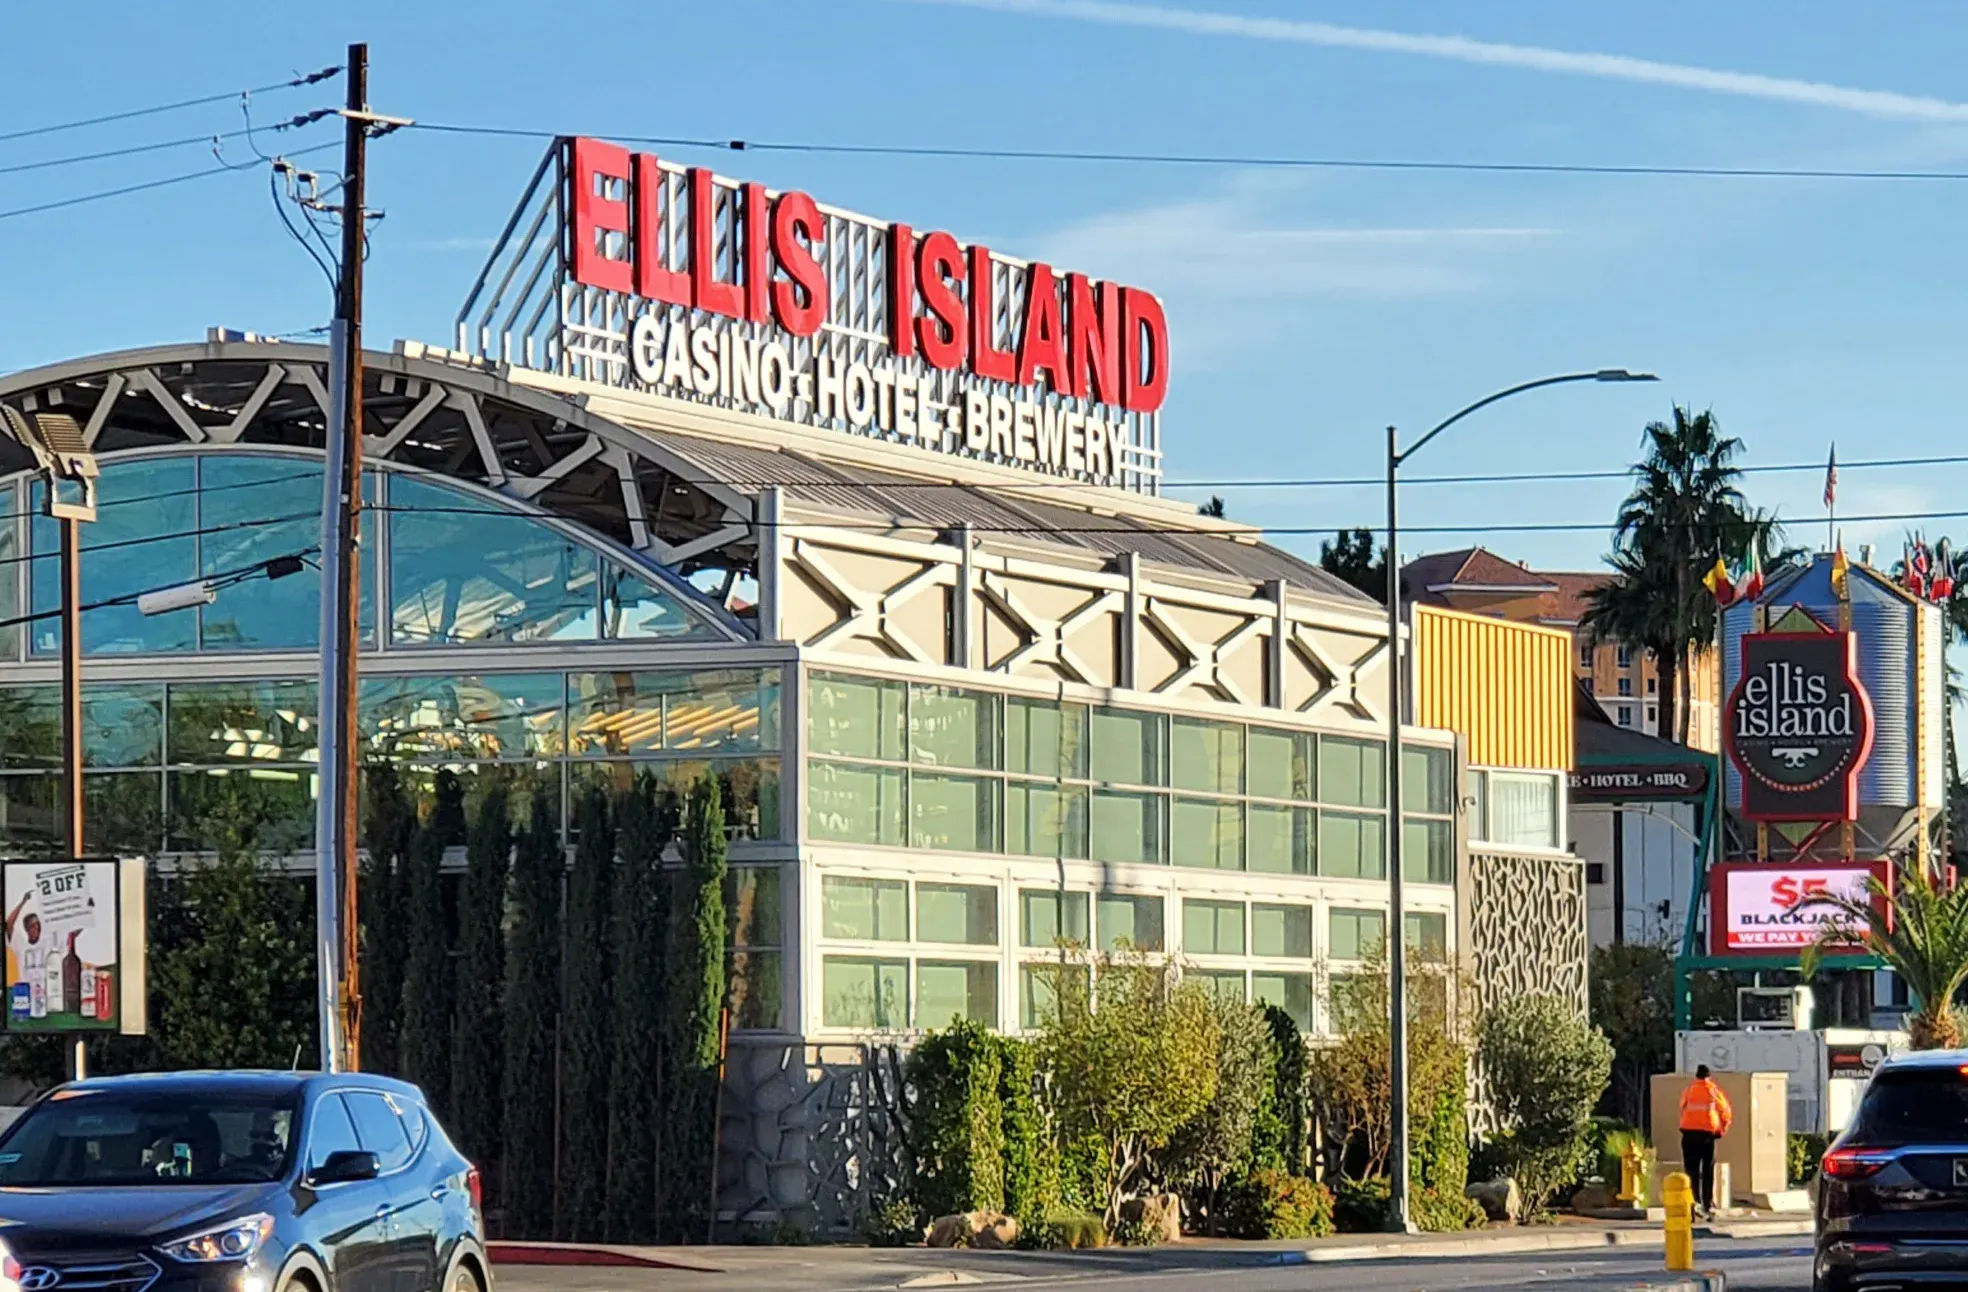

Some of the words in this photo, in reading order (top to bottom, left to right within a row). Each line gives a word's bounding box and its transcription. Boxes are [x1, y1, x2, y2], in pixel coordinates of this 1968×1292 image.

[570, 135, 828, 338] ELLIS
[889, 222, 1170, 414] ISLAND
[632, 313, 789, 408] CASINO
[817, 351, 942, 441] HOTEL
[966, 389, 1127, 478] BREWERY
[1745, 662, 1828, 705] ellis
[1736, 691, 1854, 737] island
[1590, 773, 1642, 788] HOTEL
[1652, 772, 1691, 788] BBQ
[55, 872, 86, 892] OFF
[1770, 875, 1828, 909] $5
[1740, 912, 1857, 925] BLACKJACK
[1738, 932, 1765, 943] WE
[1767, 932, 1798, 943] PAY
